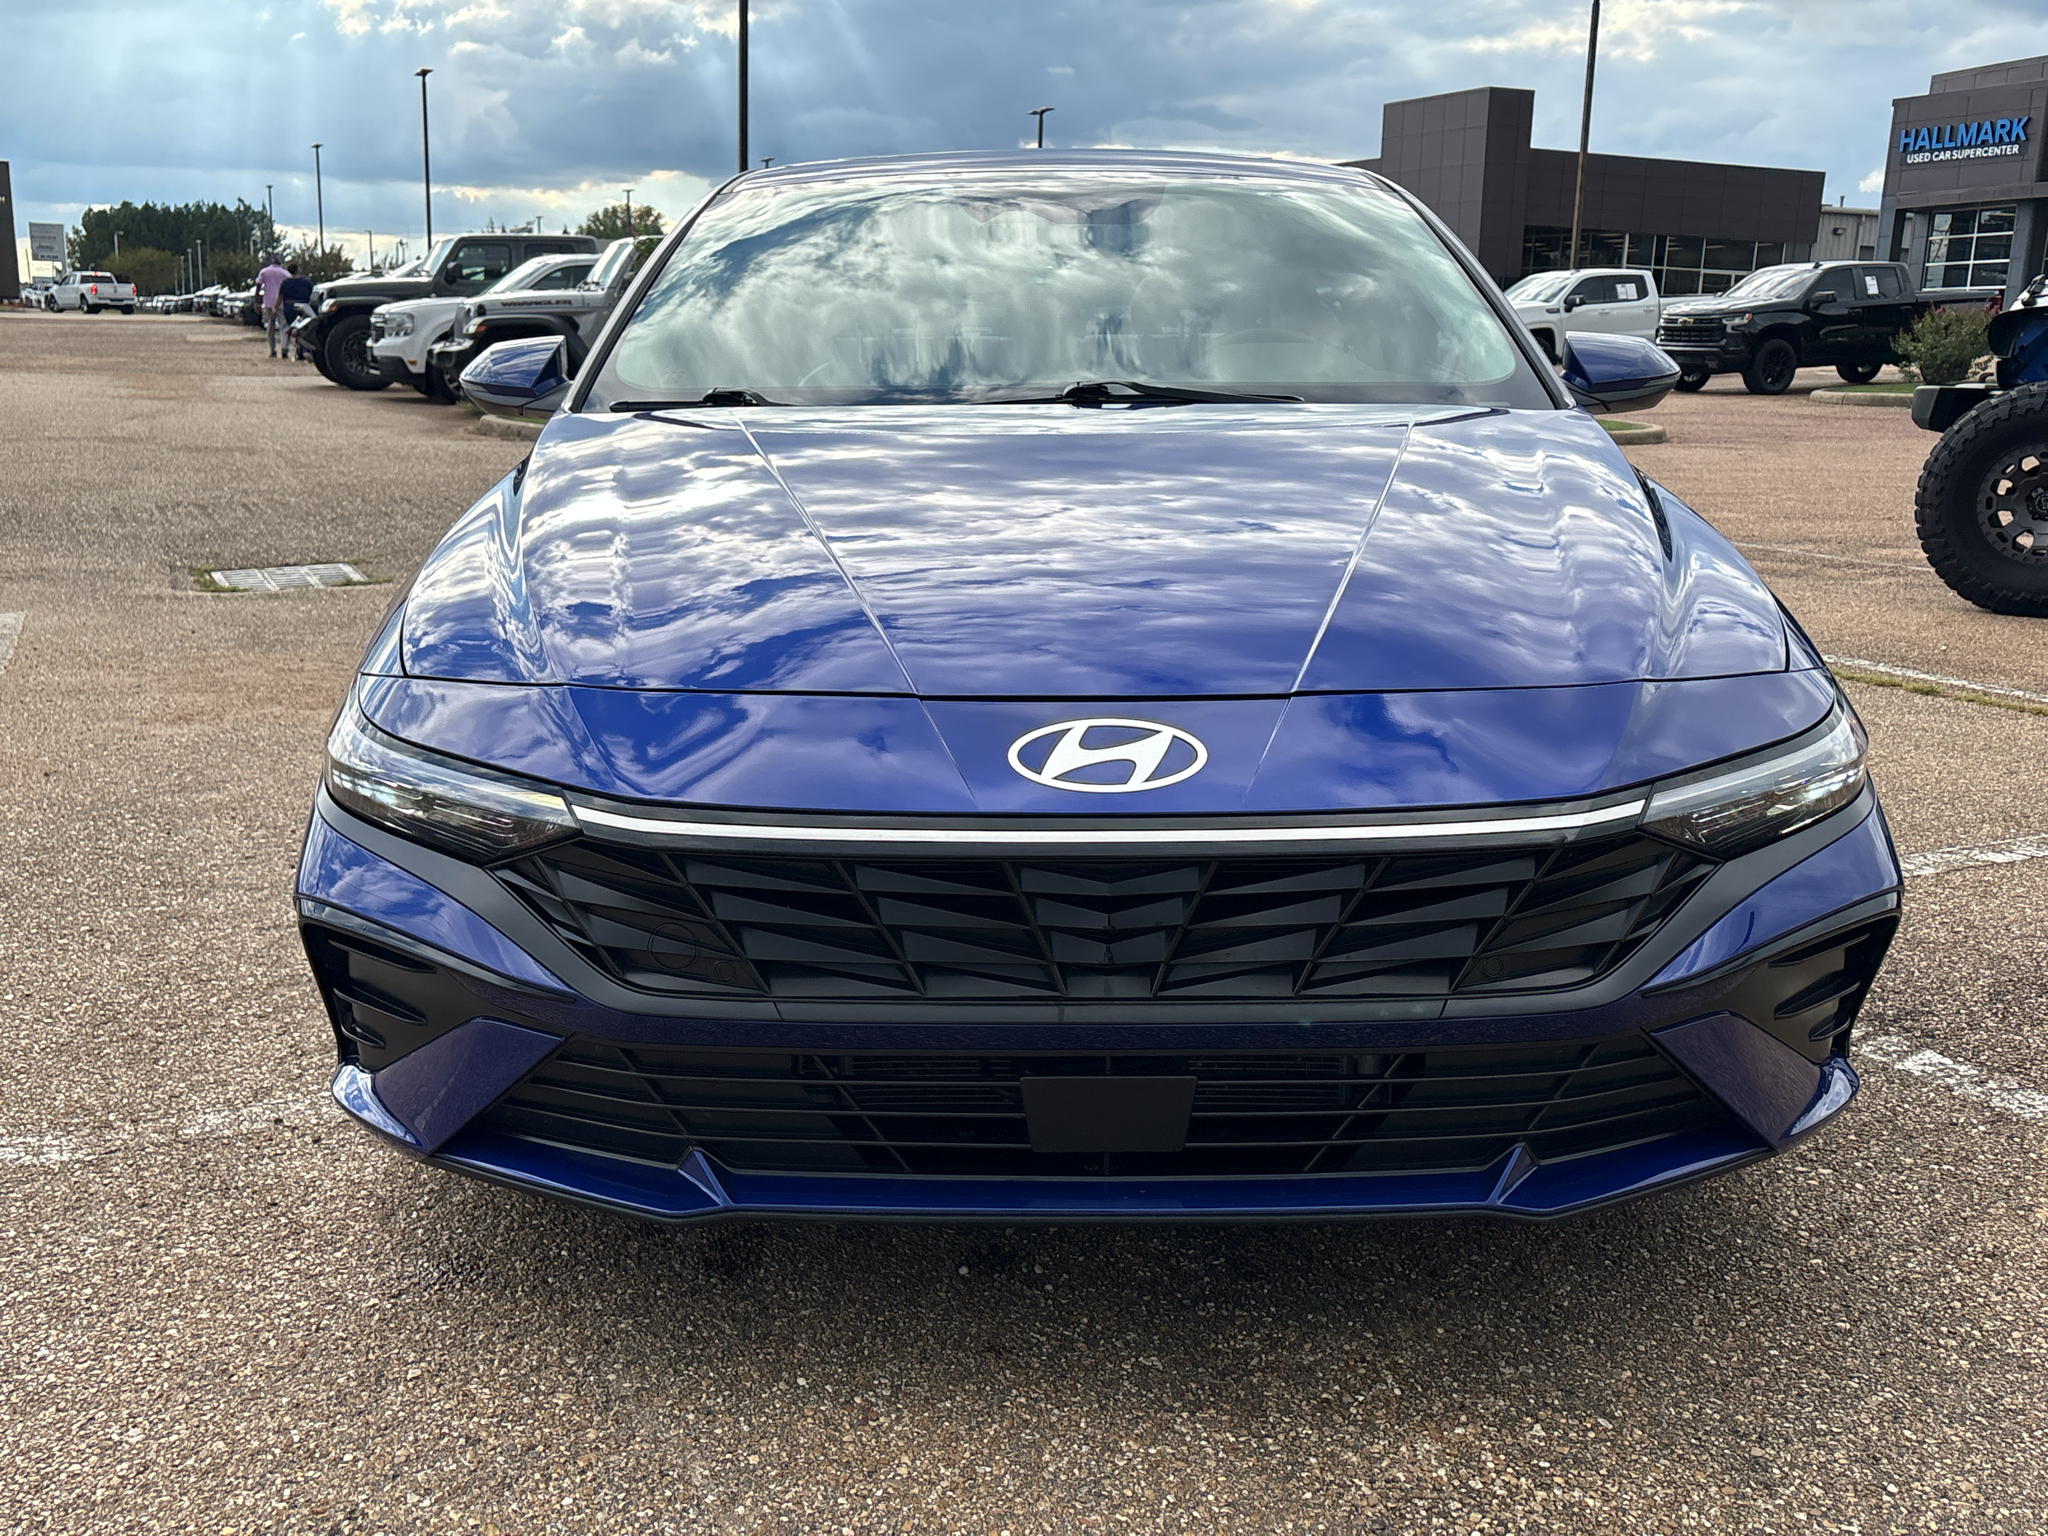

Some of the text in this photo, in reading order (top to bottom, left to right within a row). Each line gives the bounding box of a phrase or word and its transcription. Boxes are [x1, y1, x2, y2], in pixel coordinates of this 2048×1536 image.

[1899, 116, 2029, 152] HALLMARK
[1906, 144, 2020, 164] USED CAR SUPERCENTER
[501, 299, 572, 307] WRANGLER
